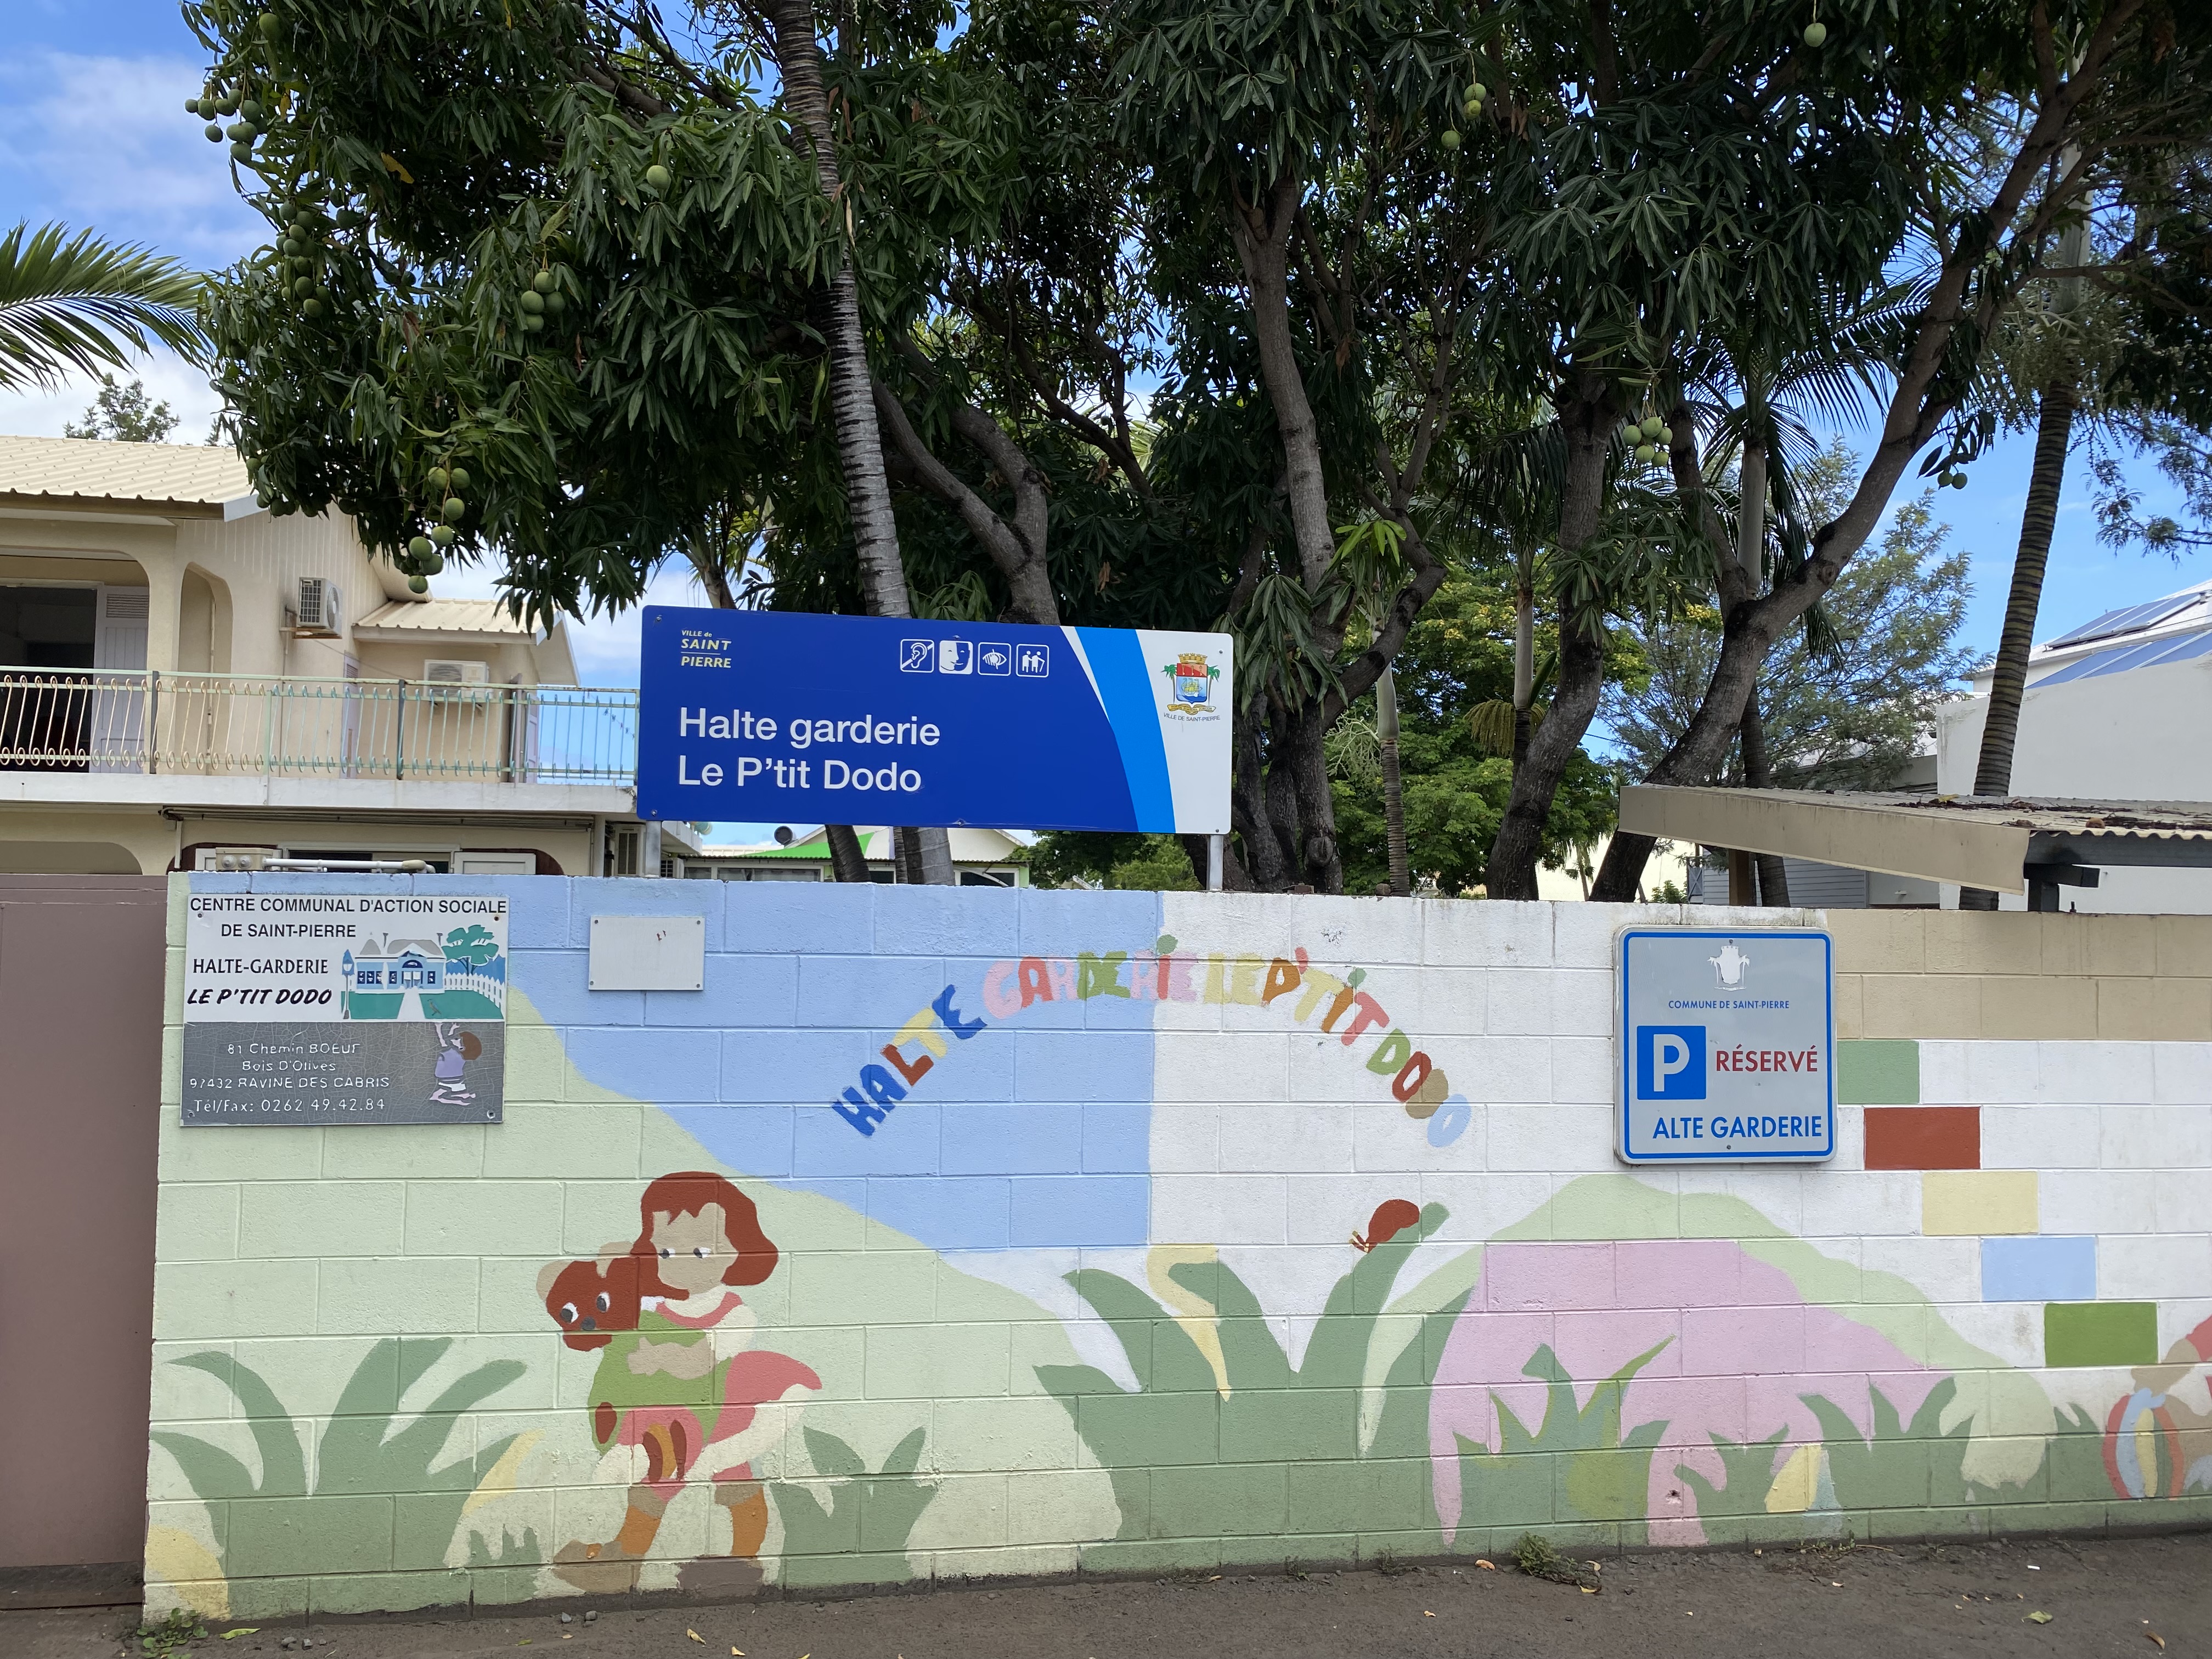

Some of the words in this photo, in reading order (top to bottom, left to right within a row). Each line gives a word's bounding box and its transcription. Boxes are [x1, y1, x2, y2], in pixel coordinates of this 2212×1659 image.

[681, 638, 732, 651] SAINT
[681, 656, 732, 668] PIERRE
[680, 707, 777, 740] Halte
[789, 714, 940, 749] garderie
[679, 755, 724, 786] Le
[737, 757, 810, 789] P'tit
[824, 760, 922, 792] Dodo
[190, 898, 255, 912] CENTRE
[260, 899, 355, 912] COMMUNAL
[360, 899, 433, 913] D'ACTION
[439, 900, 507, 913] SOCIALE
[221, 924, 242, 937] DE
[248, 924, 356, 938] SAINT-PIERRE
[193, 958, 329, 974] HALTE-GARDERIE
[187, 989, 210, 1004] LE
[217, 989, 273, 1005] P'TIT
[275, 989, 332, 1005] DODO
[1668, 1000, 1717, 1009] COMMUNE
[1719, 1001, 1730, 1009] DE
[1733, 1000, 1790, 1009] SAINT-PIERRE
[228, 1043, 242, 1054] 81
[250, 1043, 303, 1054] Chemin
[309, 1043, 360, 1054] BOEUF
[831, 984, 988, 1137] HALTE
[1203, 952, 1265, 1007] LE
[1654, 1034, 1690, 1092] P
[1716, 1043, 1818, 1072] RÉSERVÉ
[242, 1060, 273, 1071] Bois
[279, 1060, 336, 1071] D'Olives
[190, 1078, 233, 1089] 97432
[238, 1077, 293, 1088] RAVINE
[298, 1077, 328, 1088] DES
[334, 1077, 390, 1088] CABRIS
[194, 1099, 254, 1113] Tél/Fax:
[261, 1099, 302, 1111] 0262
[311, 1098, 385, 1111] 49.42.84
[1653, 1117, 1703, 1139] ALTE
[1711, 1116, 1822, 1138] GARDERIE
